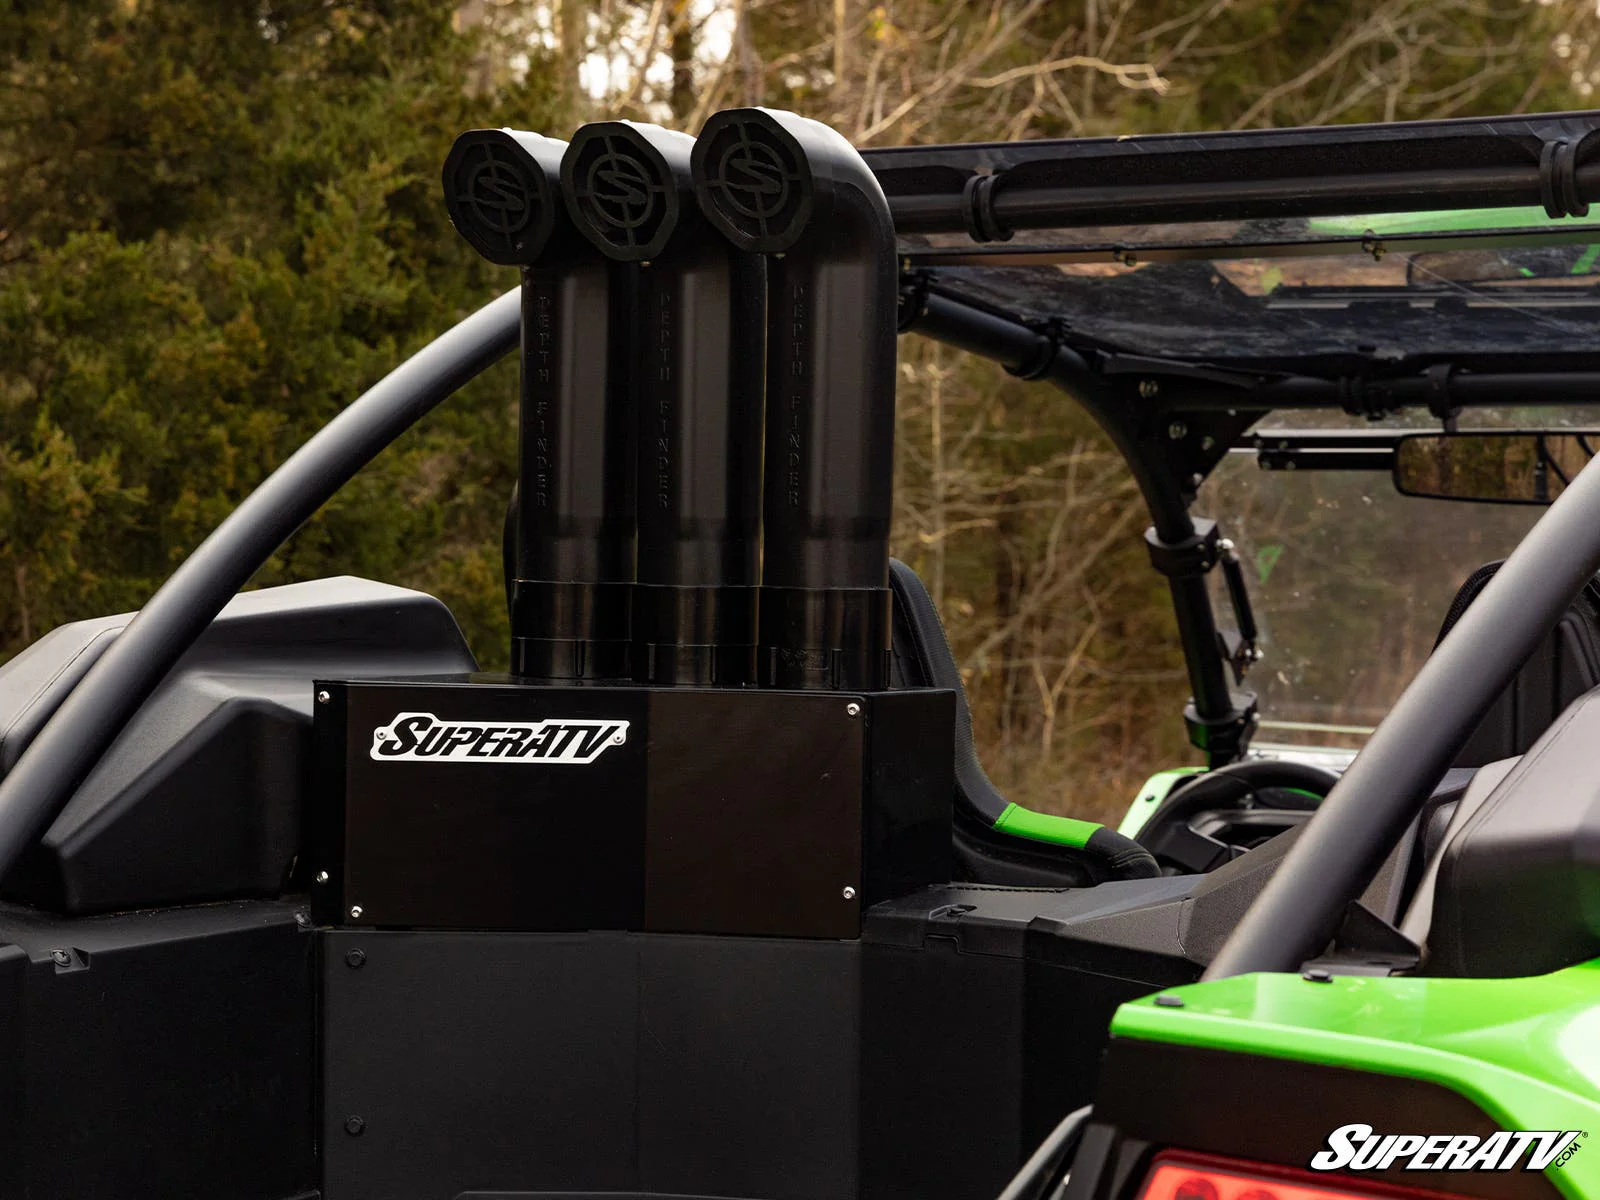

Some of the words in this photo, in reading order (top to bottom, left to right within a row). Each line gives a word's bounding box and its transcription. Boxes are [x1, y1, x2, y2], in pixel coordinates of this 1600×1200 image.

[535, 295, 552, 383] DEPTH
[657, 289, 672, 381] DEPTH
[790, 283, 806, 378] DEPTH
[534, 400, 552, 509] FINDER
[656, 400, 672, 511] FINDER
[787, 395, 804, 511] FINDER
